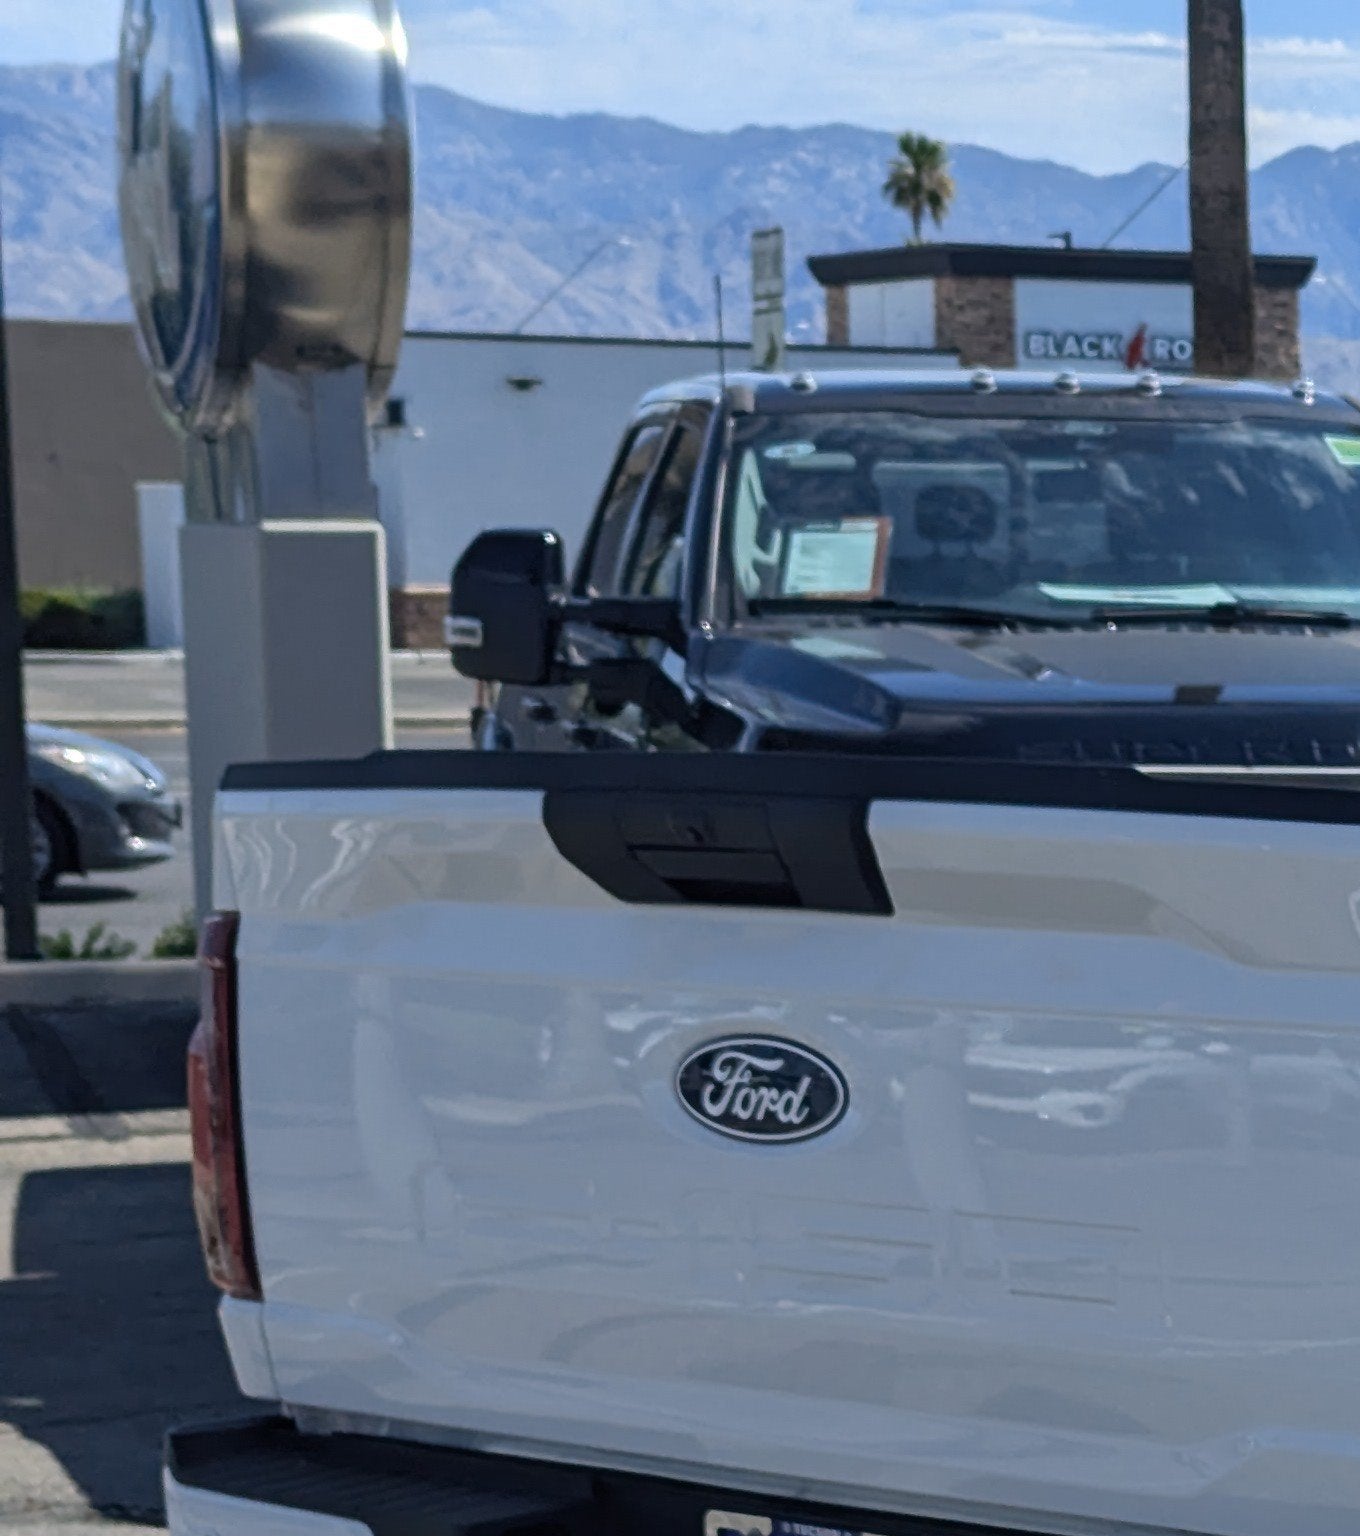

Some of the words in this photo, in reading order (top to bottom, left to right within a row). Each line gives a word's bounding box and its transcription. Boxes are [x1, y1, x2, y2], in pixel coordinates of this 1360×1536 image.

[1028, 333, 1122, 358] BLACK
[1155, 338, 1193, 361] RO
[702, 1051, 812, 1125] Ford
